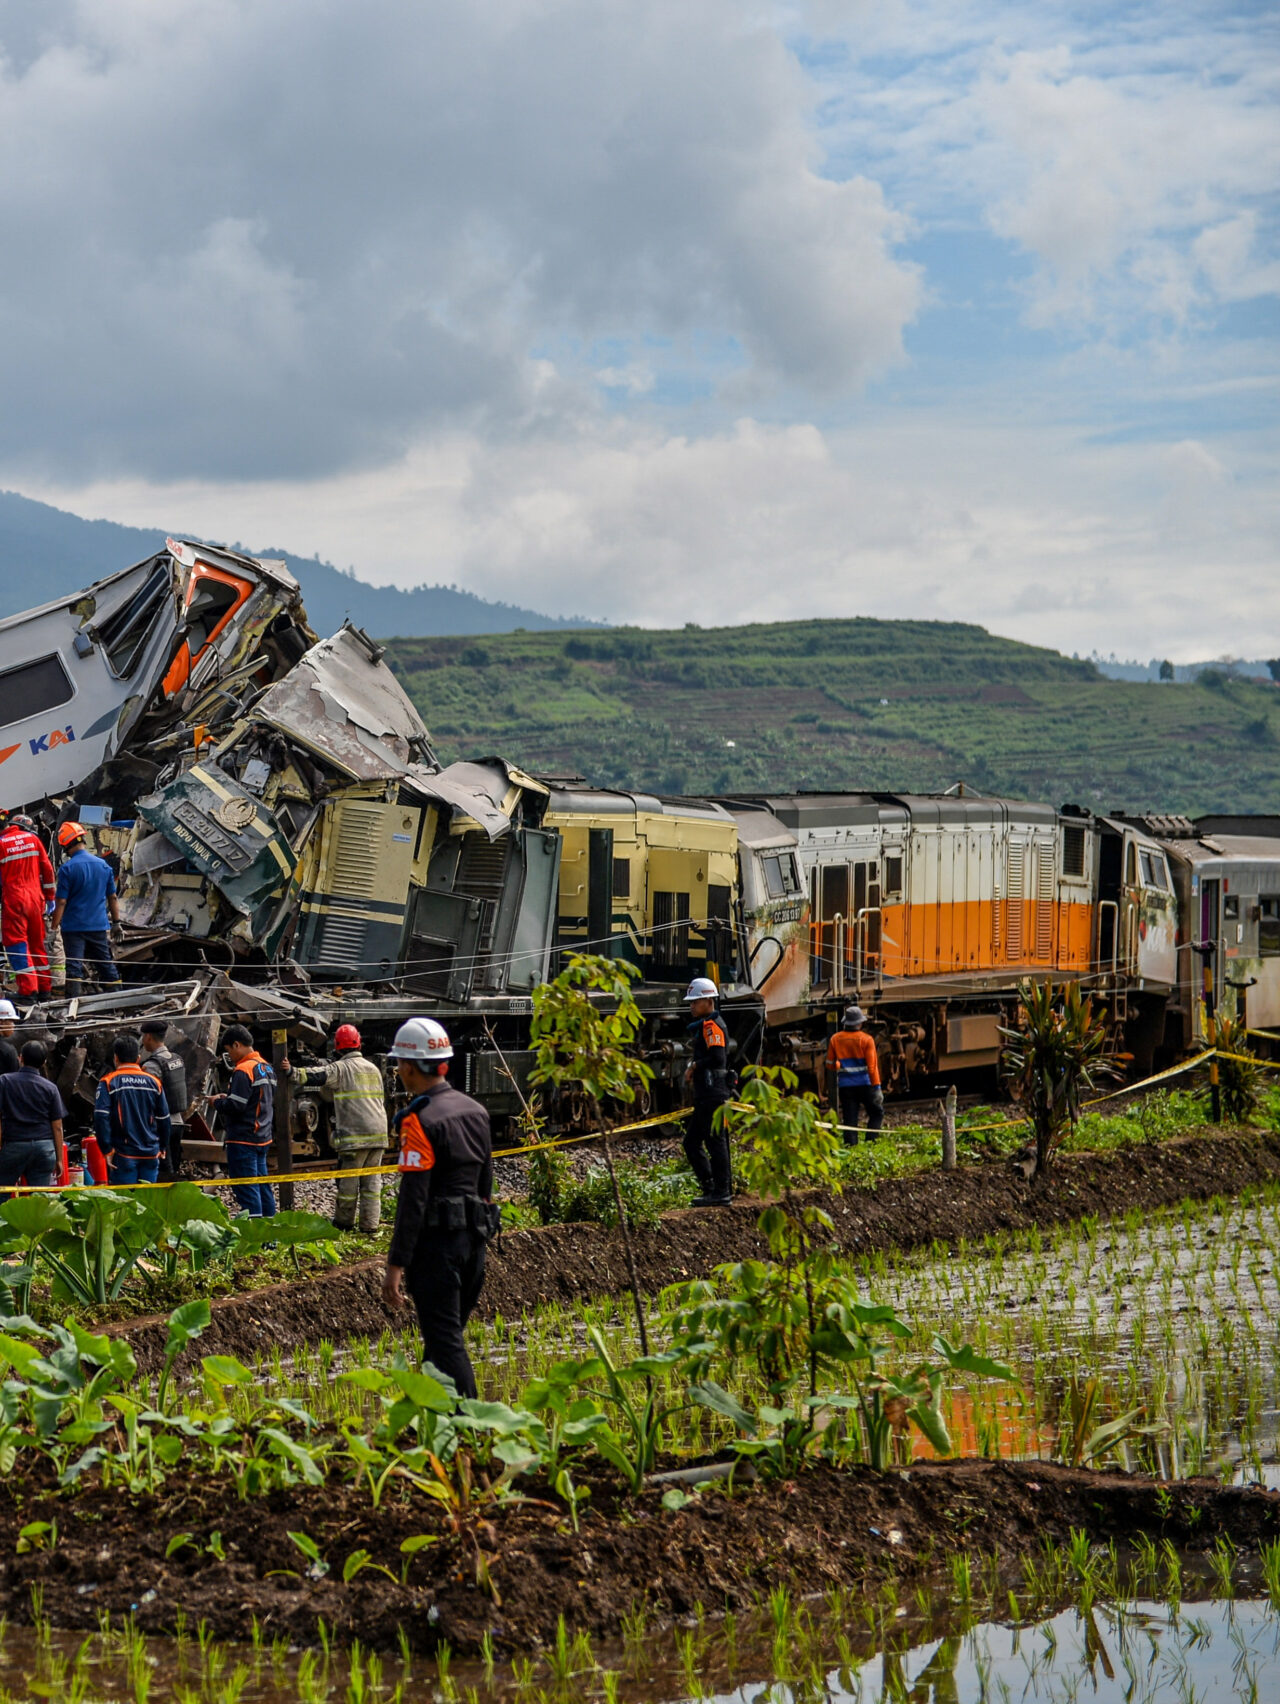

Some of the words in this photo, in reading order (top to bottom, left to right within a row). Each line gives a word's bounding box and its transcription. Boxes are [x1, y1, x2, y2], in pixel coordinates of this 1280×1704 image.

[173, 824, 193, 843] DEPO
[190, 840, 212, 861] INDUK
[194, 819, 216, 839] 201
[211, 835, 231, 849] 77
[226, 847, 244, 861] 17
[774, 911, 782, 923] CC
